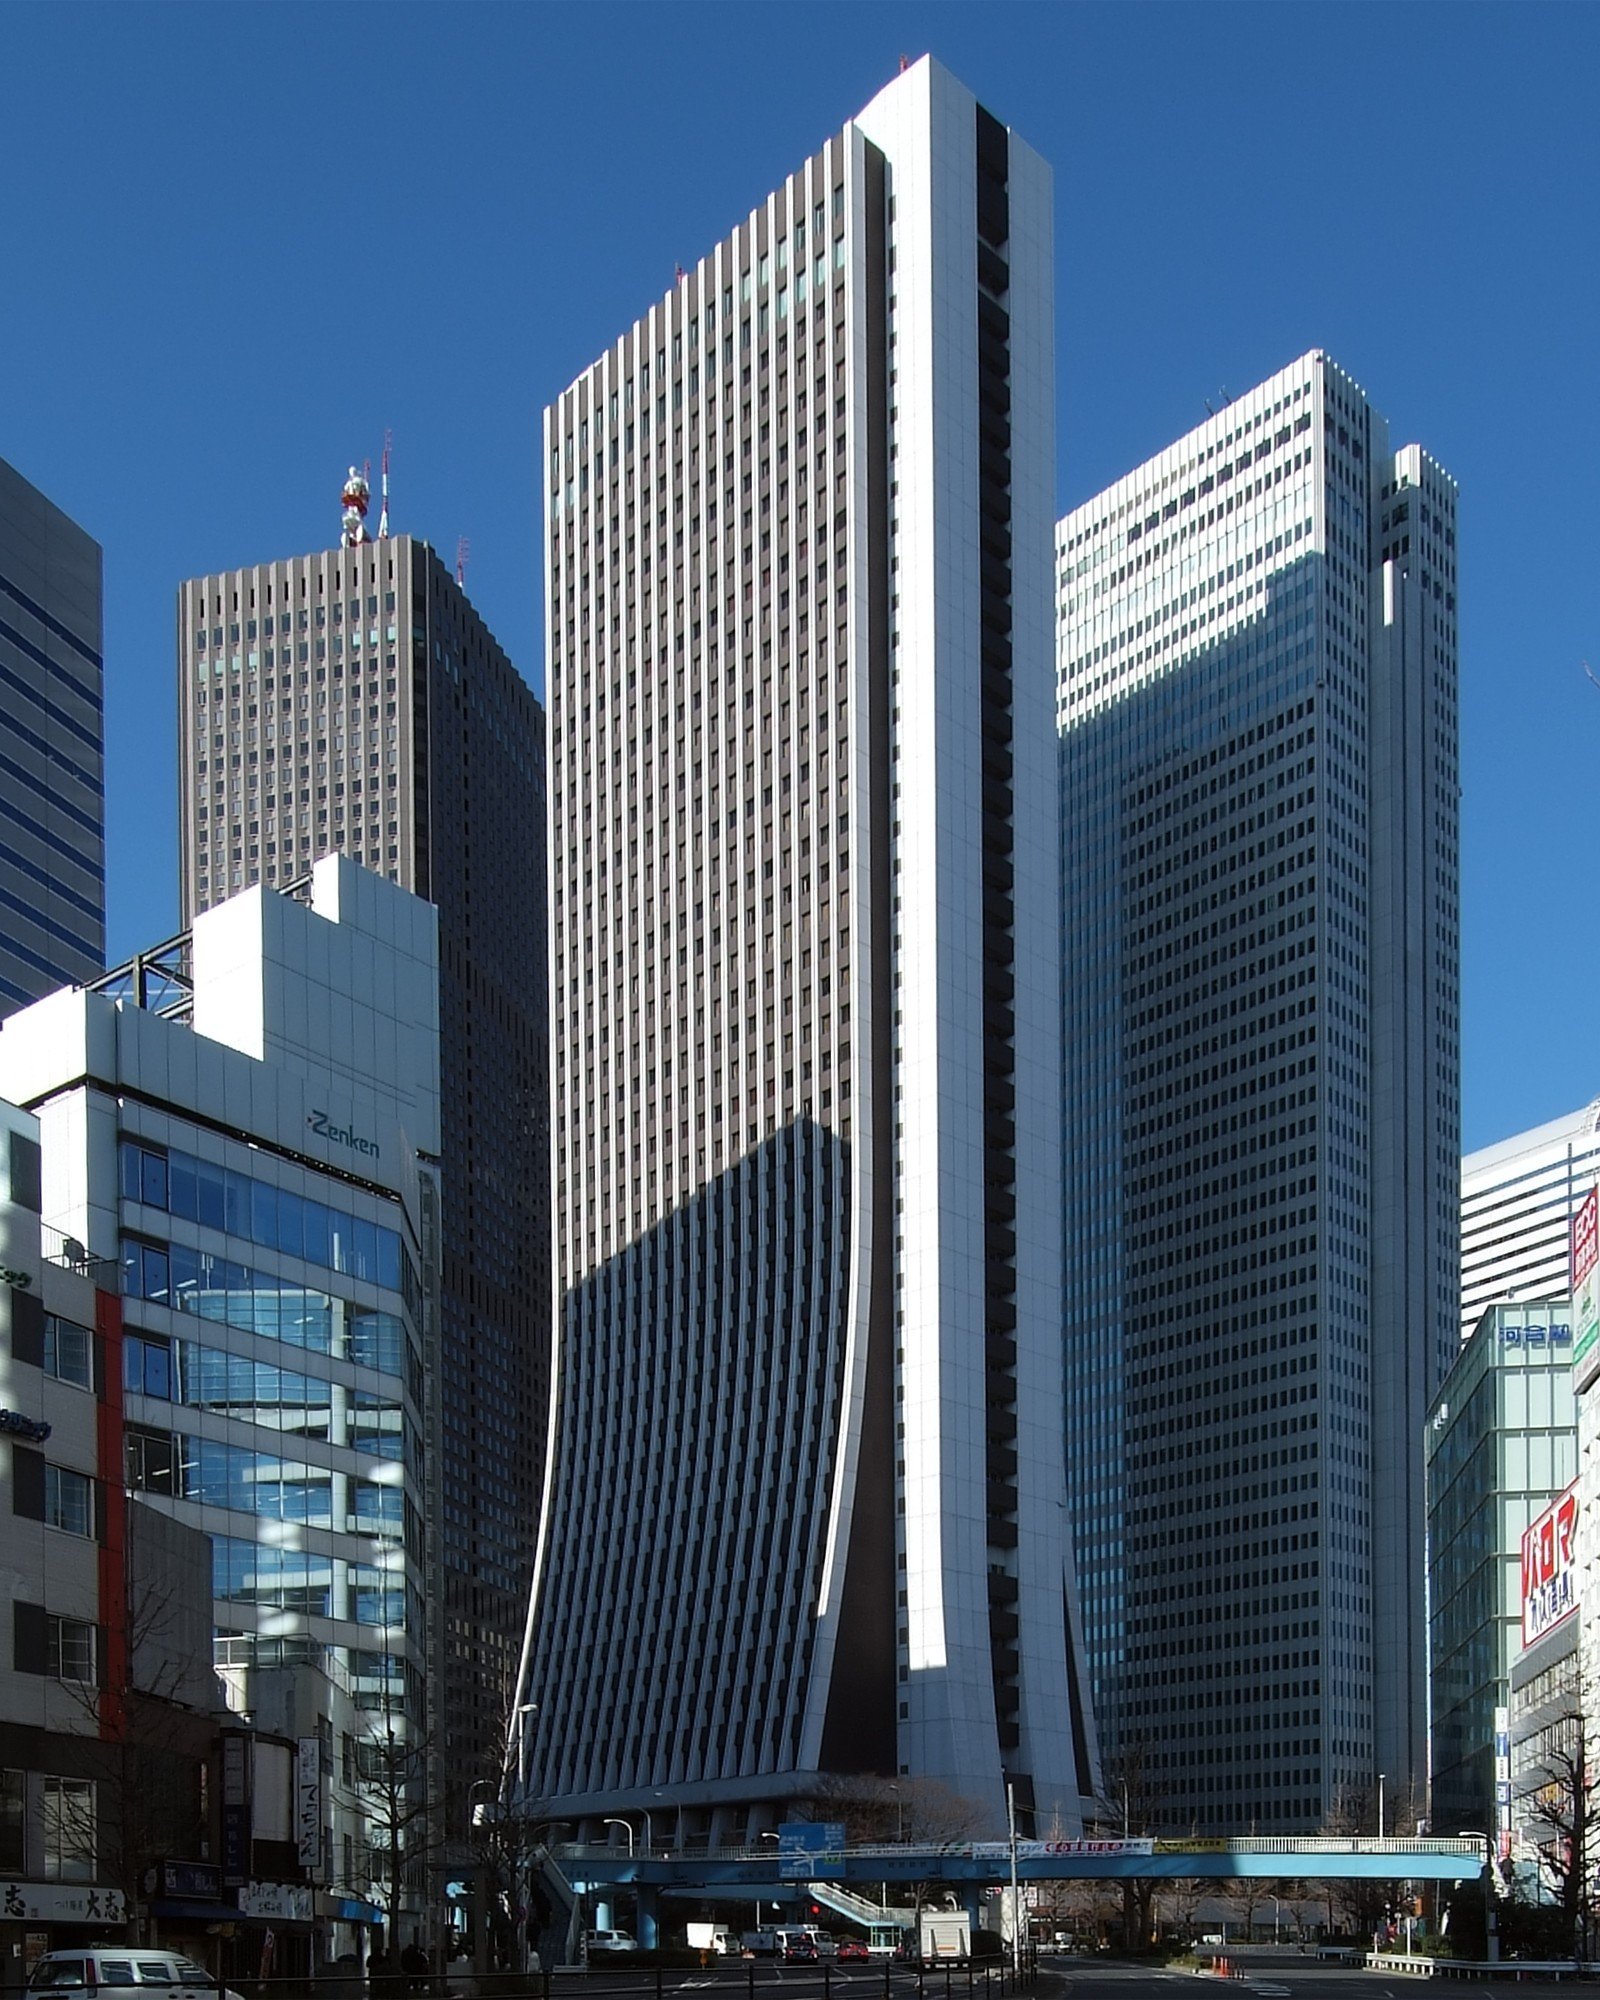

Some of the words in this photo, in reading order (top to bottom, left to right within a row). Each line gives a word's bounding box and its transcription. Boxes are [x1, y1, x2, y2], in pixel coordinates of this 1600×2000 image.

[312, 1109, 380, 1159] Zenken
[1575, 1195, 1597, 1244] ECC
[1521, 1494, 1576, 1598] パロマ
